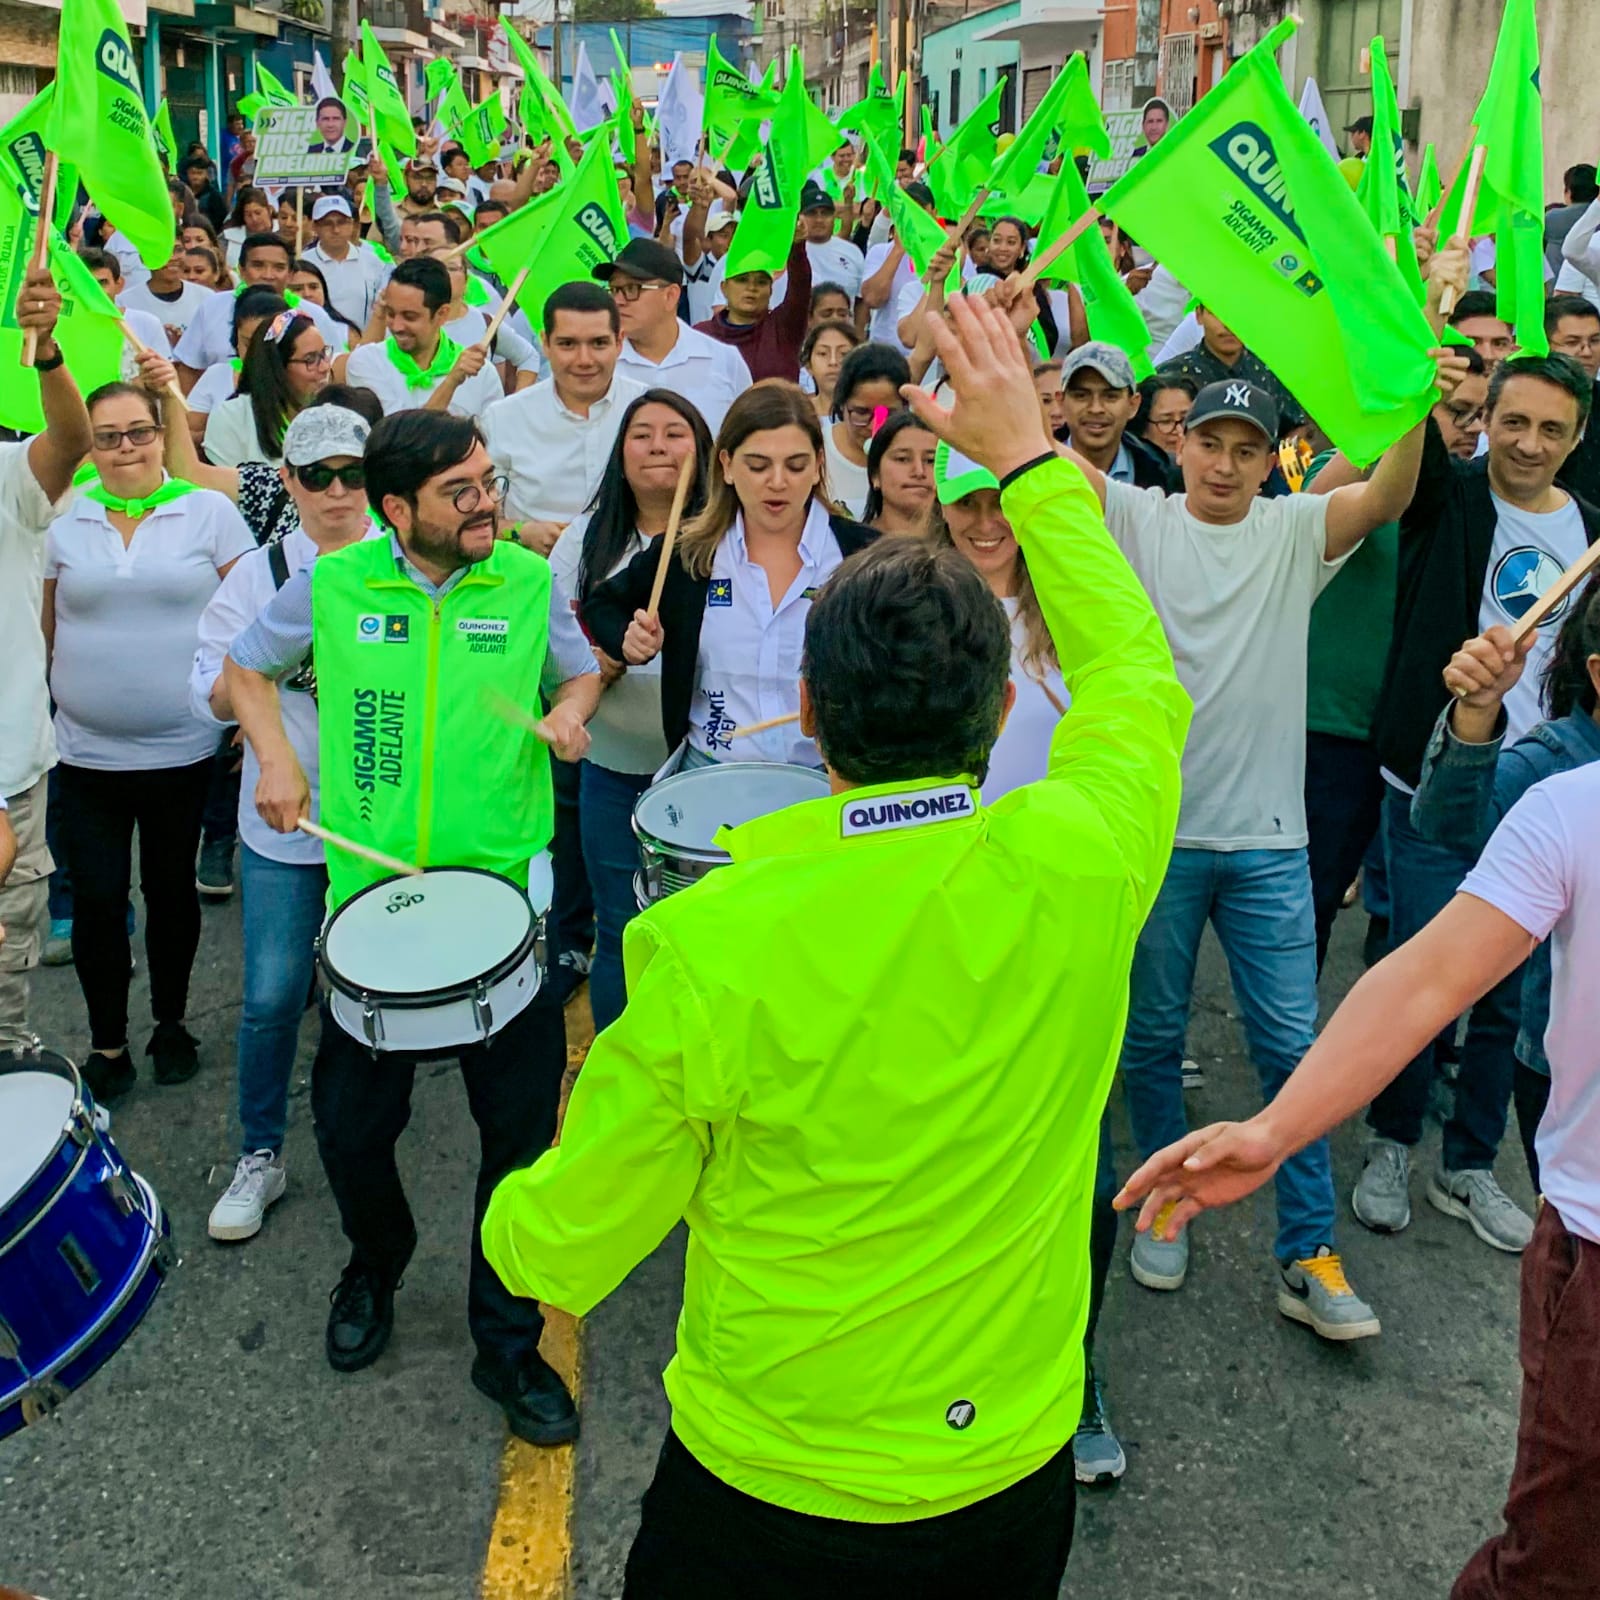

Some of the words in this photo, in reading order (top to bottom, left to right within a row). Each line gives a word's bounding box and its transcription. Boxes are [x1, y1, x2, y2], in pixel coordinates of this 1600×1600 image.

[268, 111, 318, 132] SIGA
[260, 134, 310, 155] MOS
[261, 154, 345, 174] ADELANTE
[1228, 133, 1294, 214] QUIN
[1222, 213, 1266, 254] ADELANTE
[1229, 200, 1278, 246] SIGAMOS
[466, 633, 507, 644] SIGAMOS
[469, 644, 506, 655] ADELANTE
[354, 688, 377, 793] SIGAMOS
[379, 689, 405, 788] ADELANTE
[849, 793, 970, 828] QUIÑONEZ
